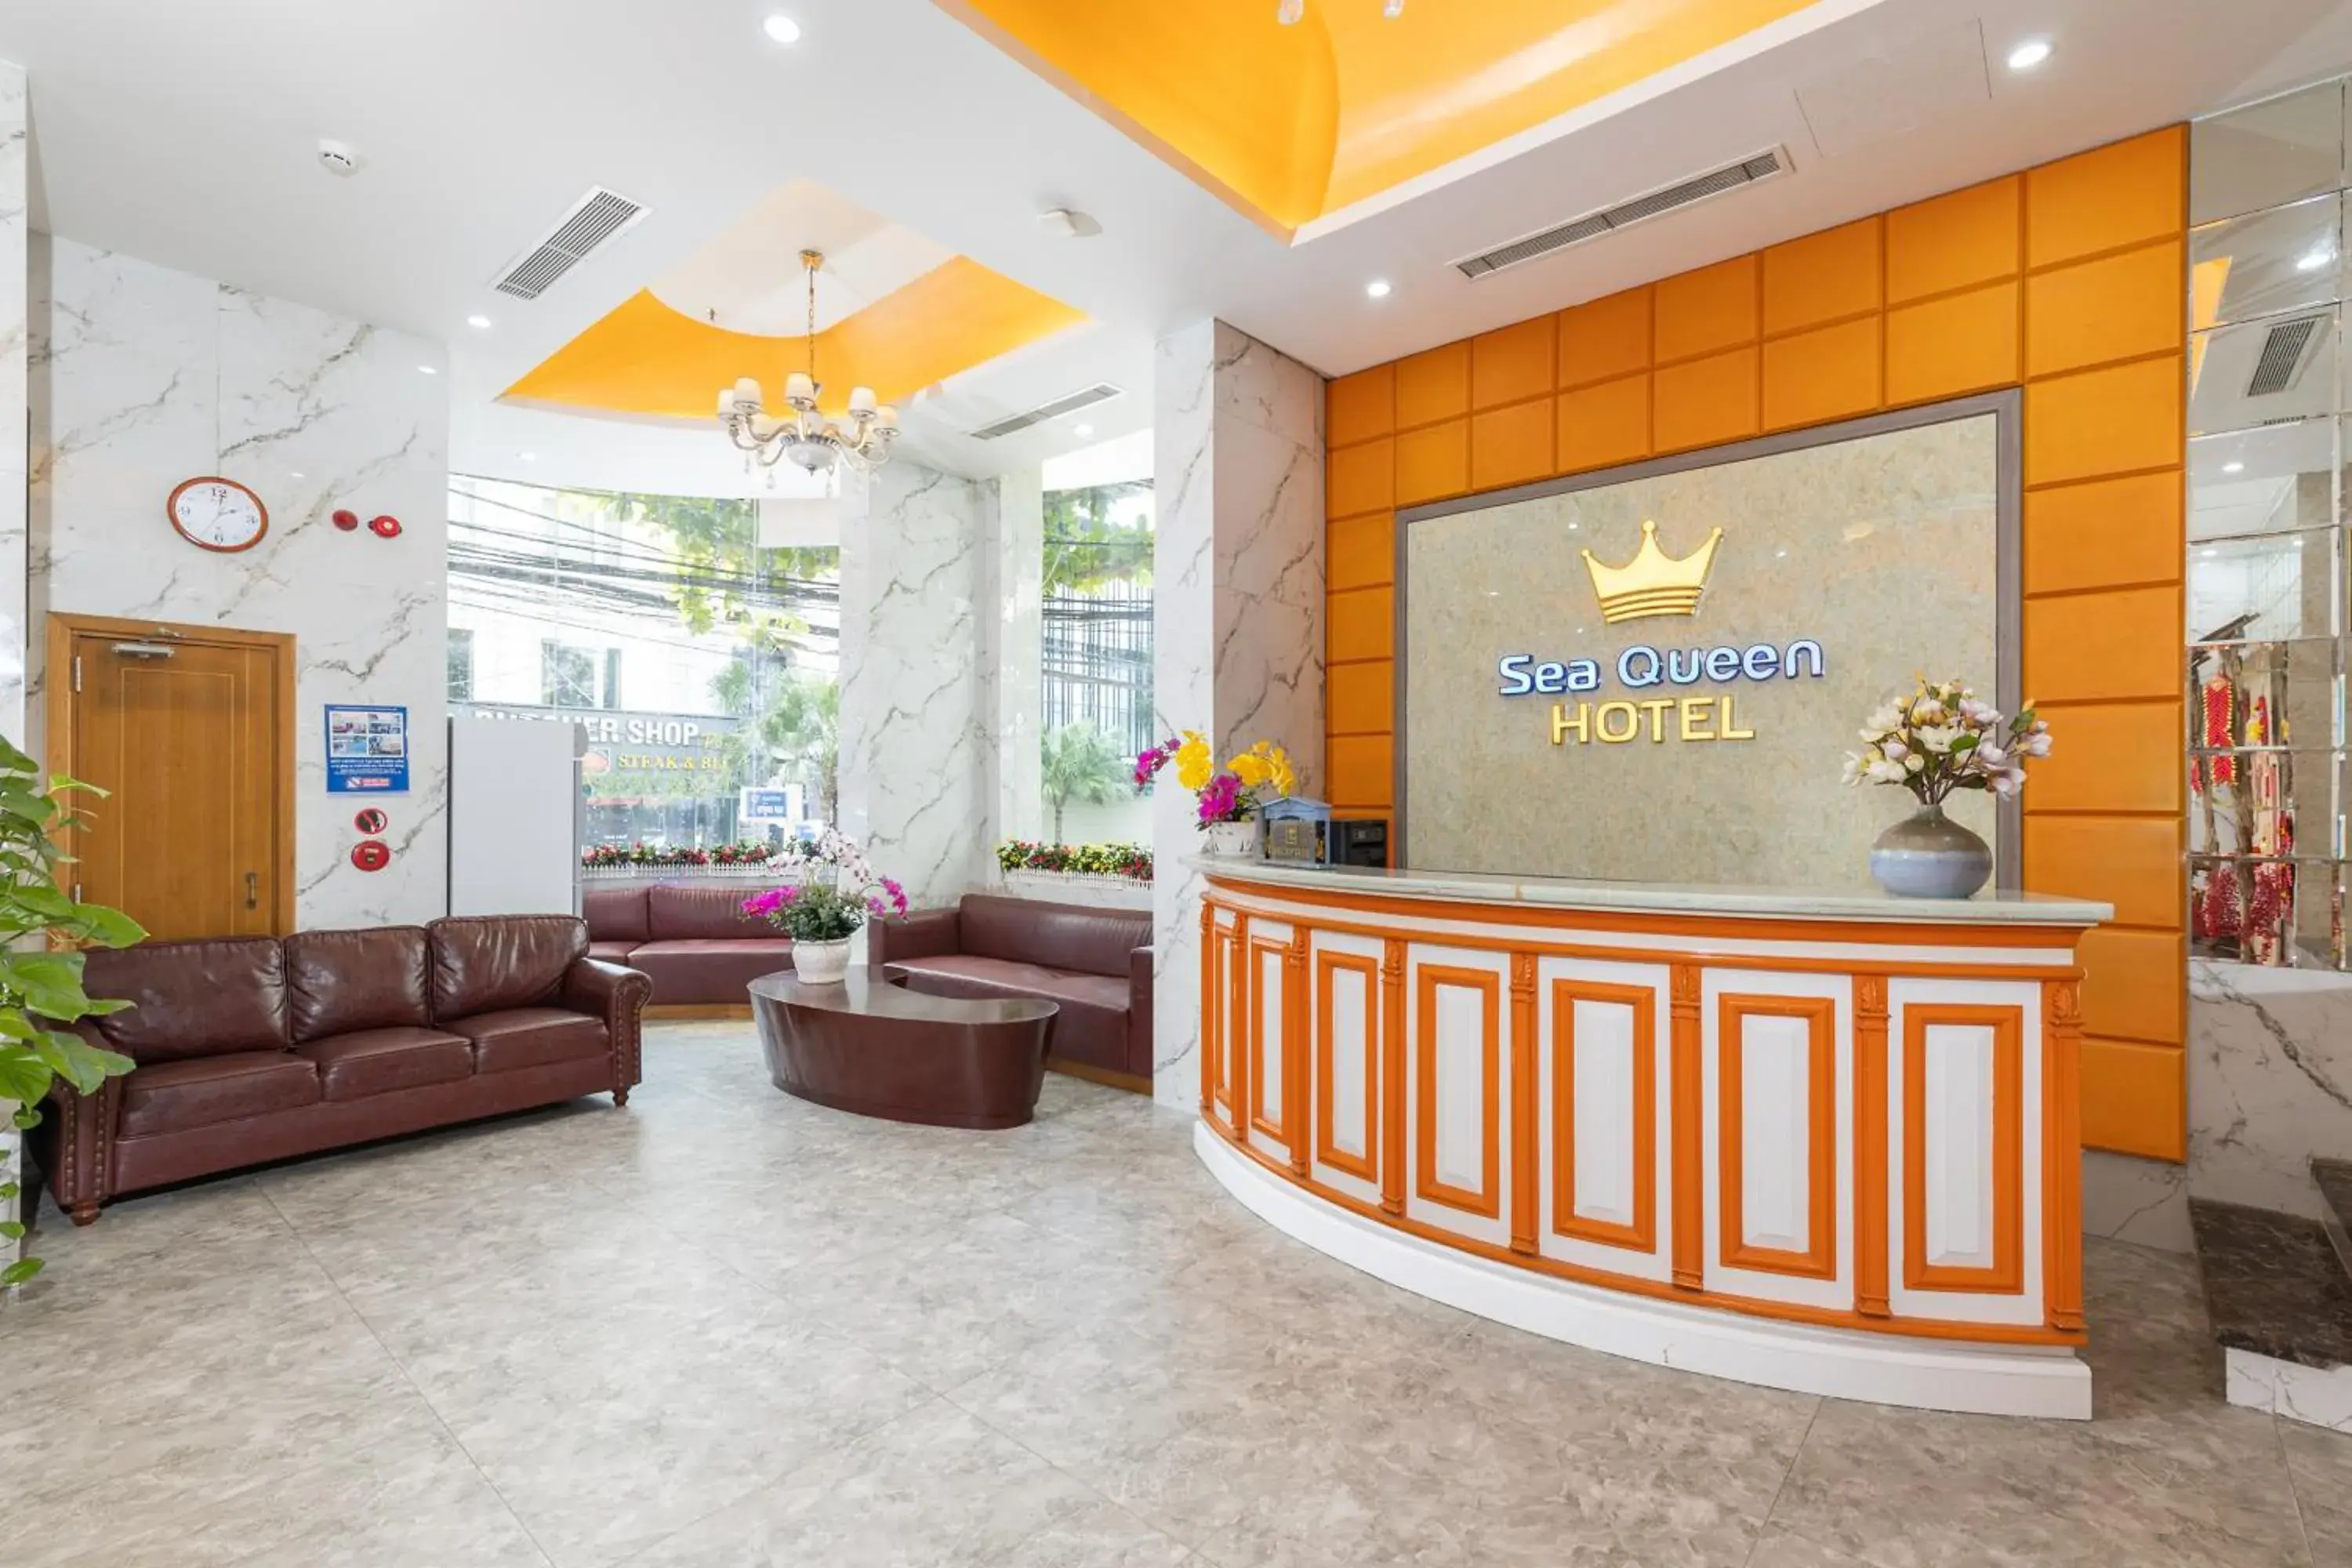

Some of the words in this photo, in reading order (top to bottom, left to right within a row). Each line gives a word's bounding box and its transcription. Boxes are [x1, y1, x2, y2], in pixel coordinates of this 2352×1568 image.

[1498, 652, 1601, 696] Sea
[1617, 637, 1826, 689] Queen
[627, 719, 699, 746] SHOP
[1551, 695, 1756, 746] HOTEL
[618, 753, 678, 770] STEAK
